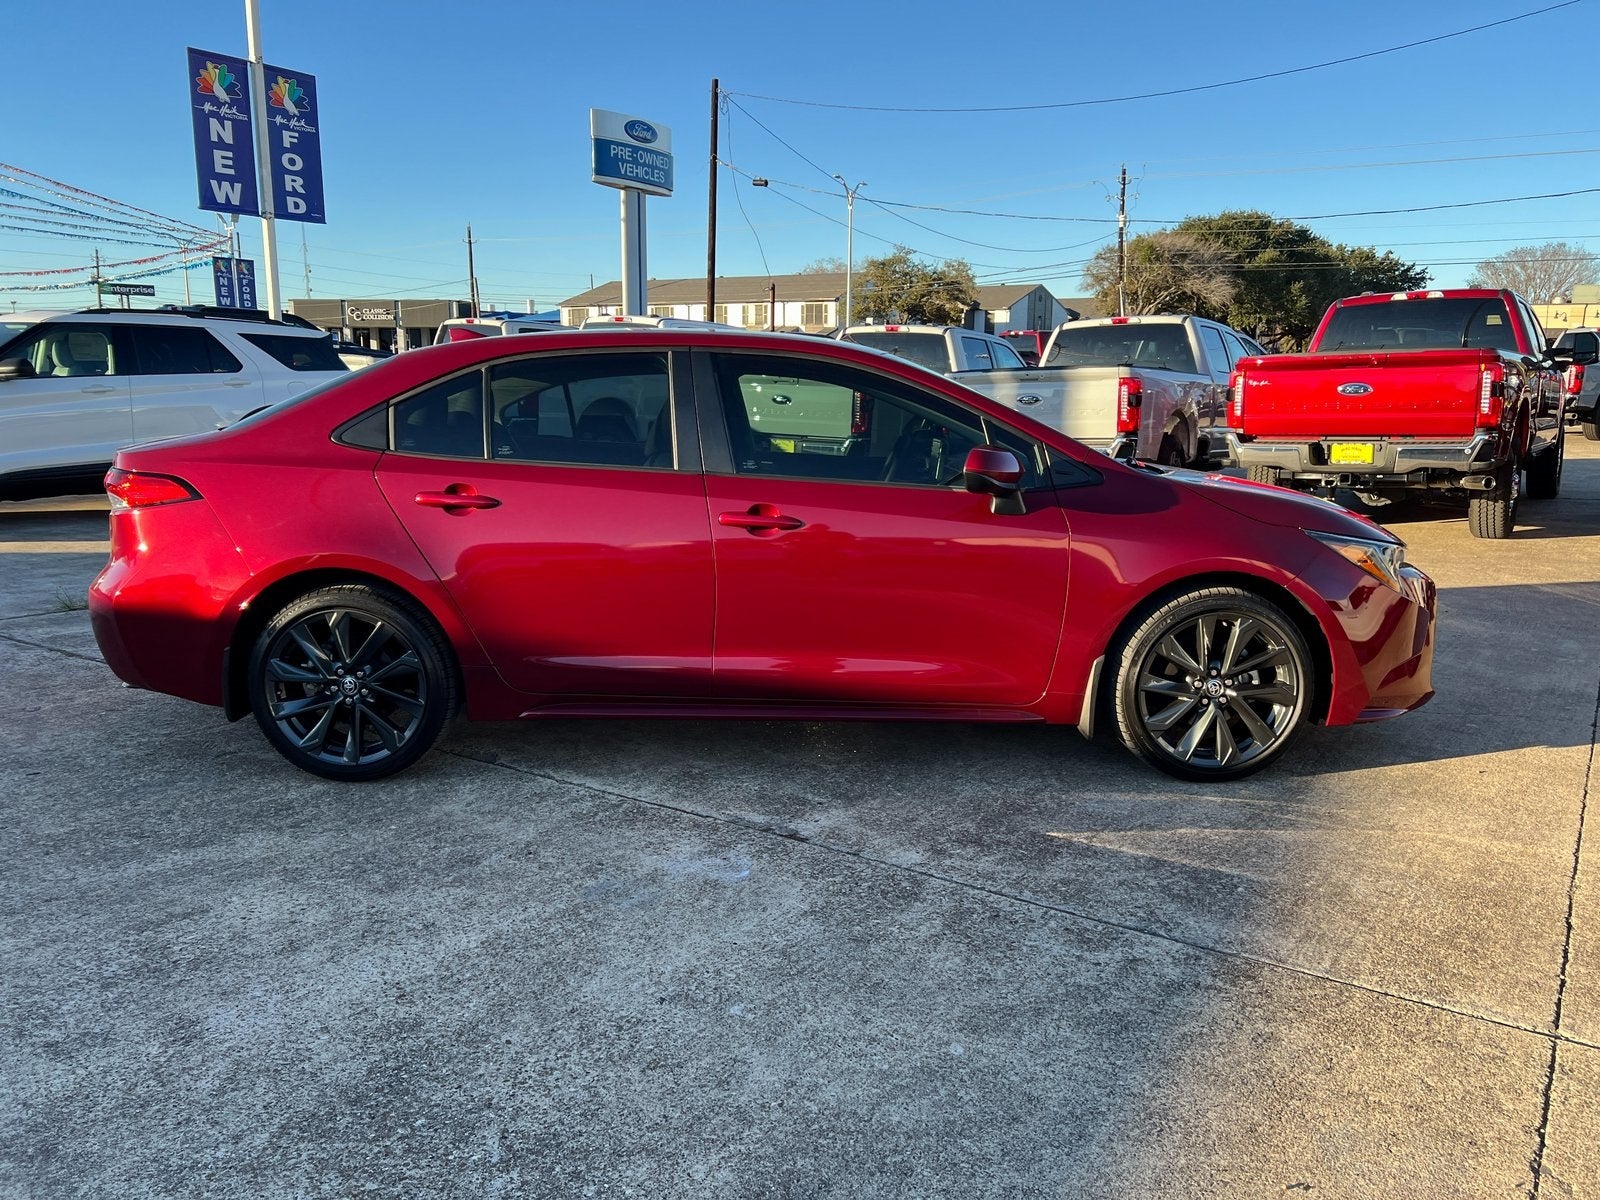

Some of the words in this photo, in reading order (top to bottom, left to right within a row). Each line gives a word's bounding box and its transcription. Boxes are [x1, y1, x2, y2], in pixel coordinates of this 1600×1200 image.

[224, 113, 248, 121] VICTORIA
[633, 123, 652, 139] Ford
[209, 117, 241, 206] NEW
[610, 144, 669, 170] PRE-OWNED
[281, 130, 306, 214] FORD
[618, 162, 665, 184] VEHICLES
[219, 276, 230, 306] NEW
[242, 278, 252, 308] FORD
